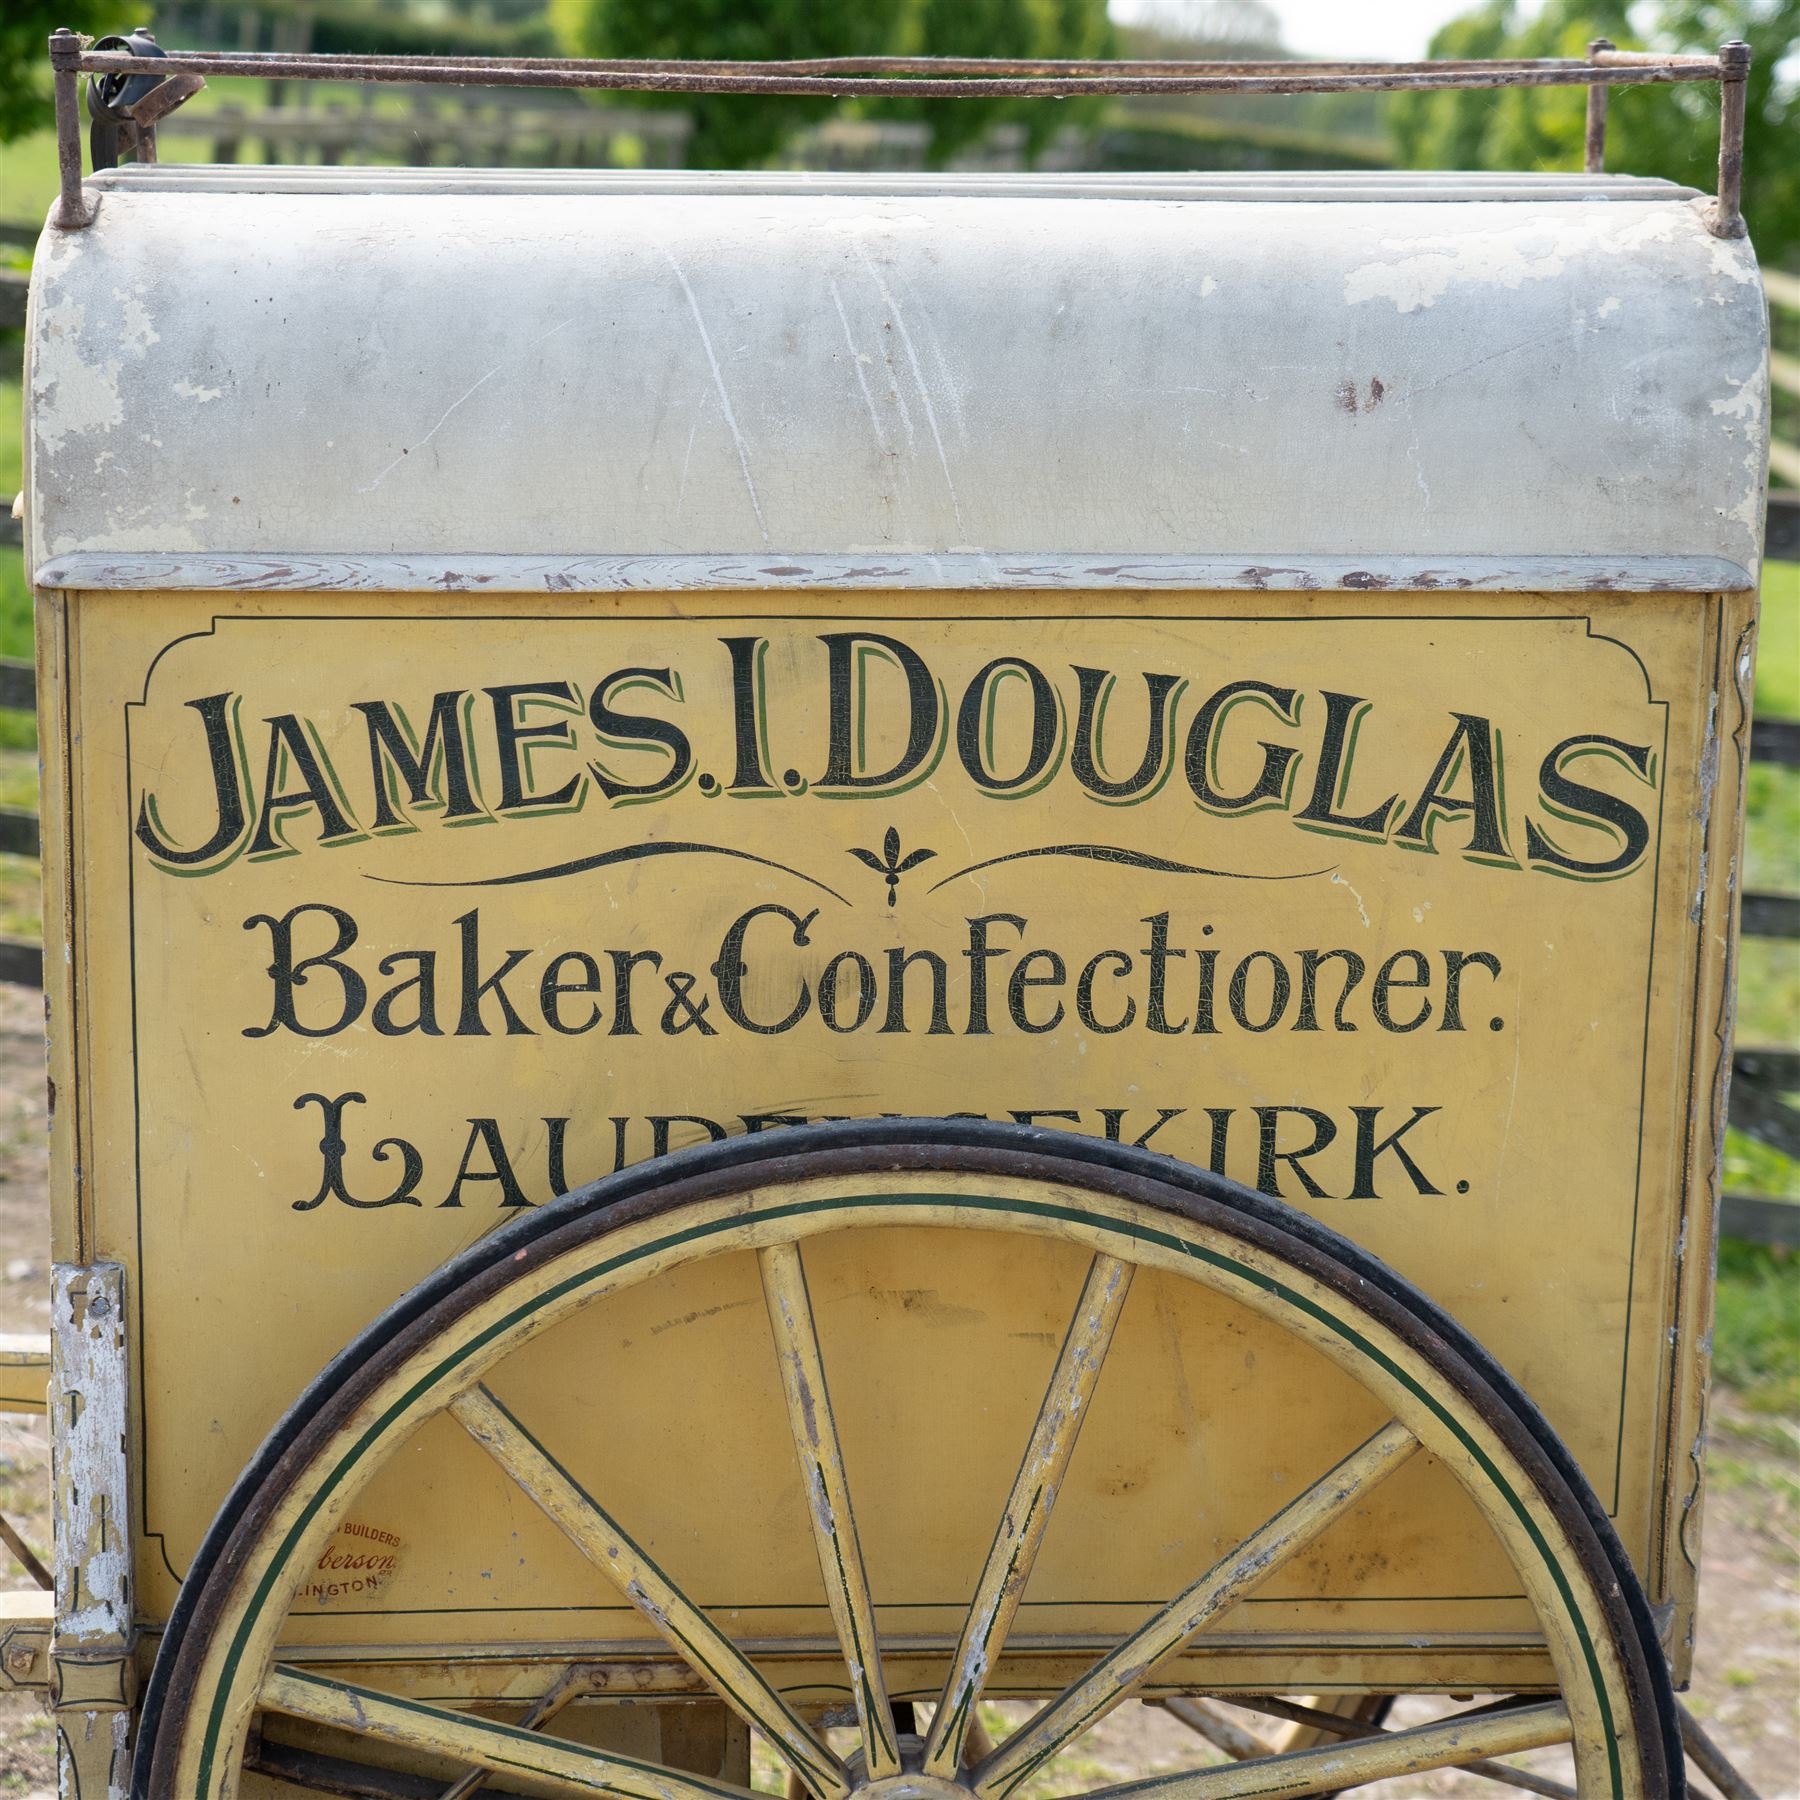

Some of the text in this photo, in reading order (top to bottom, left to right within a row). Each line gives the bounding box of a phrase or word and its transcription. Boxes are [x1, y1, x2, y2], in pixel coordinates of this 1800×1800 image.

[241, 902, 1504, 1037] Baker & Confectioner.
[344, 1522, 401, 1548] BUILDERS
